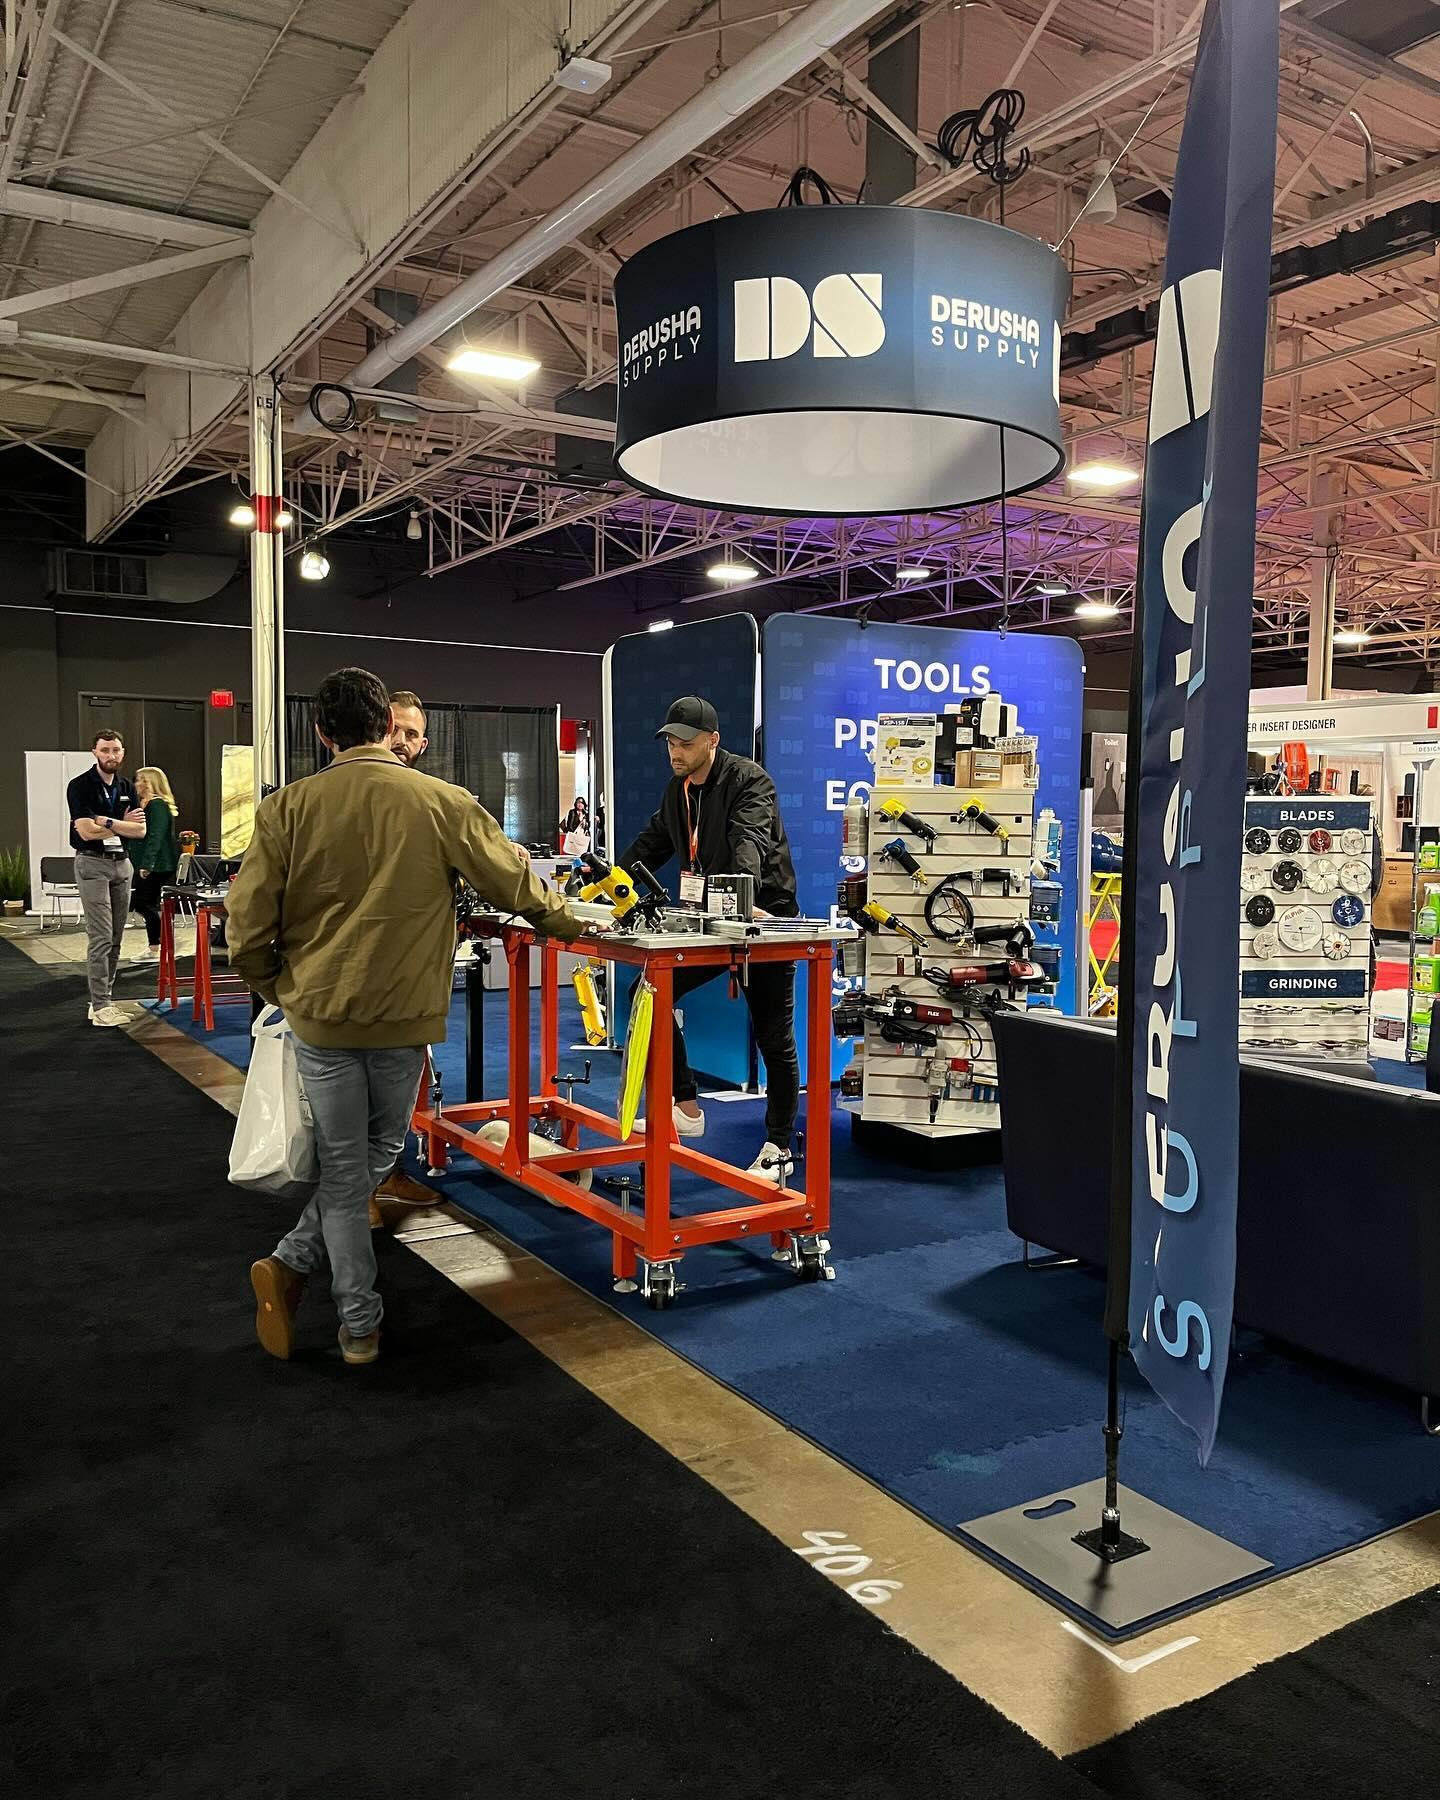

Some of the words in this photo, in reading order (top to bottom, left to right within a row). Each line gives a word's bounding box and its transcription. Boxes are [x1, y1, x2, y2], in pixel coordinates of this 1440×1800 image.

[623, 304, 701, 367] DERUSHA
[734, 273, 886, 363] DS
[931, 294, 1040, 347] DERUSHA
[623, 333, 701, 388] SUPPLY
[931, 327, 1040, 369] SUPPLY
[873, 658, 991, 695] TOOLS
[1259, 721, 1290, 732] INSERT
[1292, 718, 1336, 731] DESIGNER
[1280, 810, 1335, 821] BLADES
[1268, 978, 1338, 990] GRINDING
[791, 1530, 905, 1605] 406
